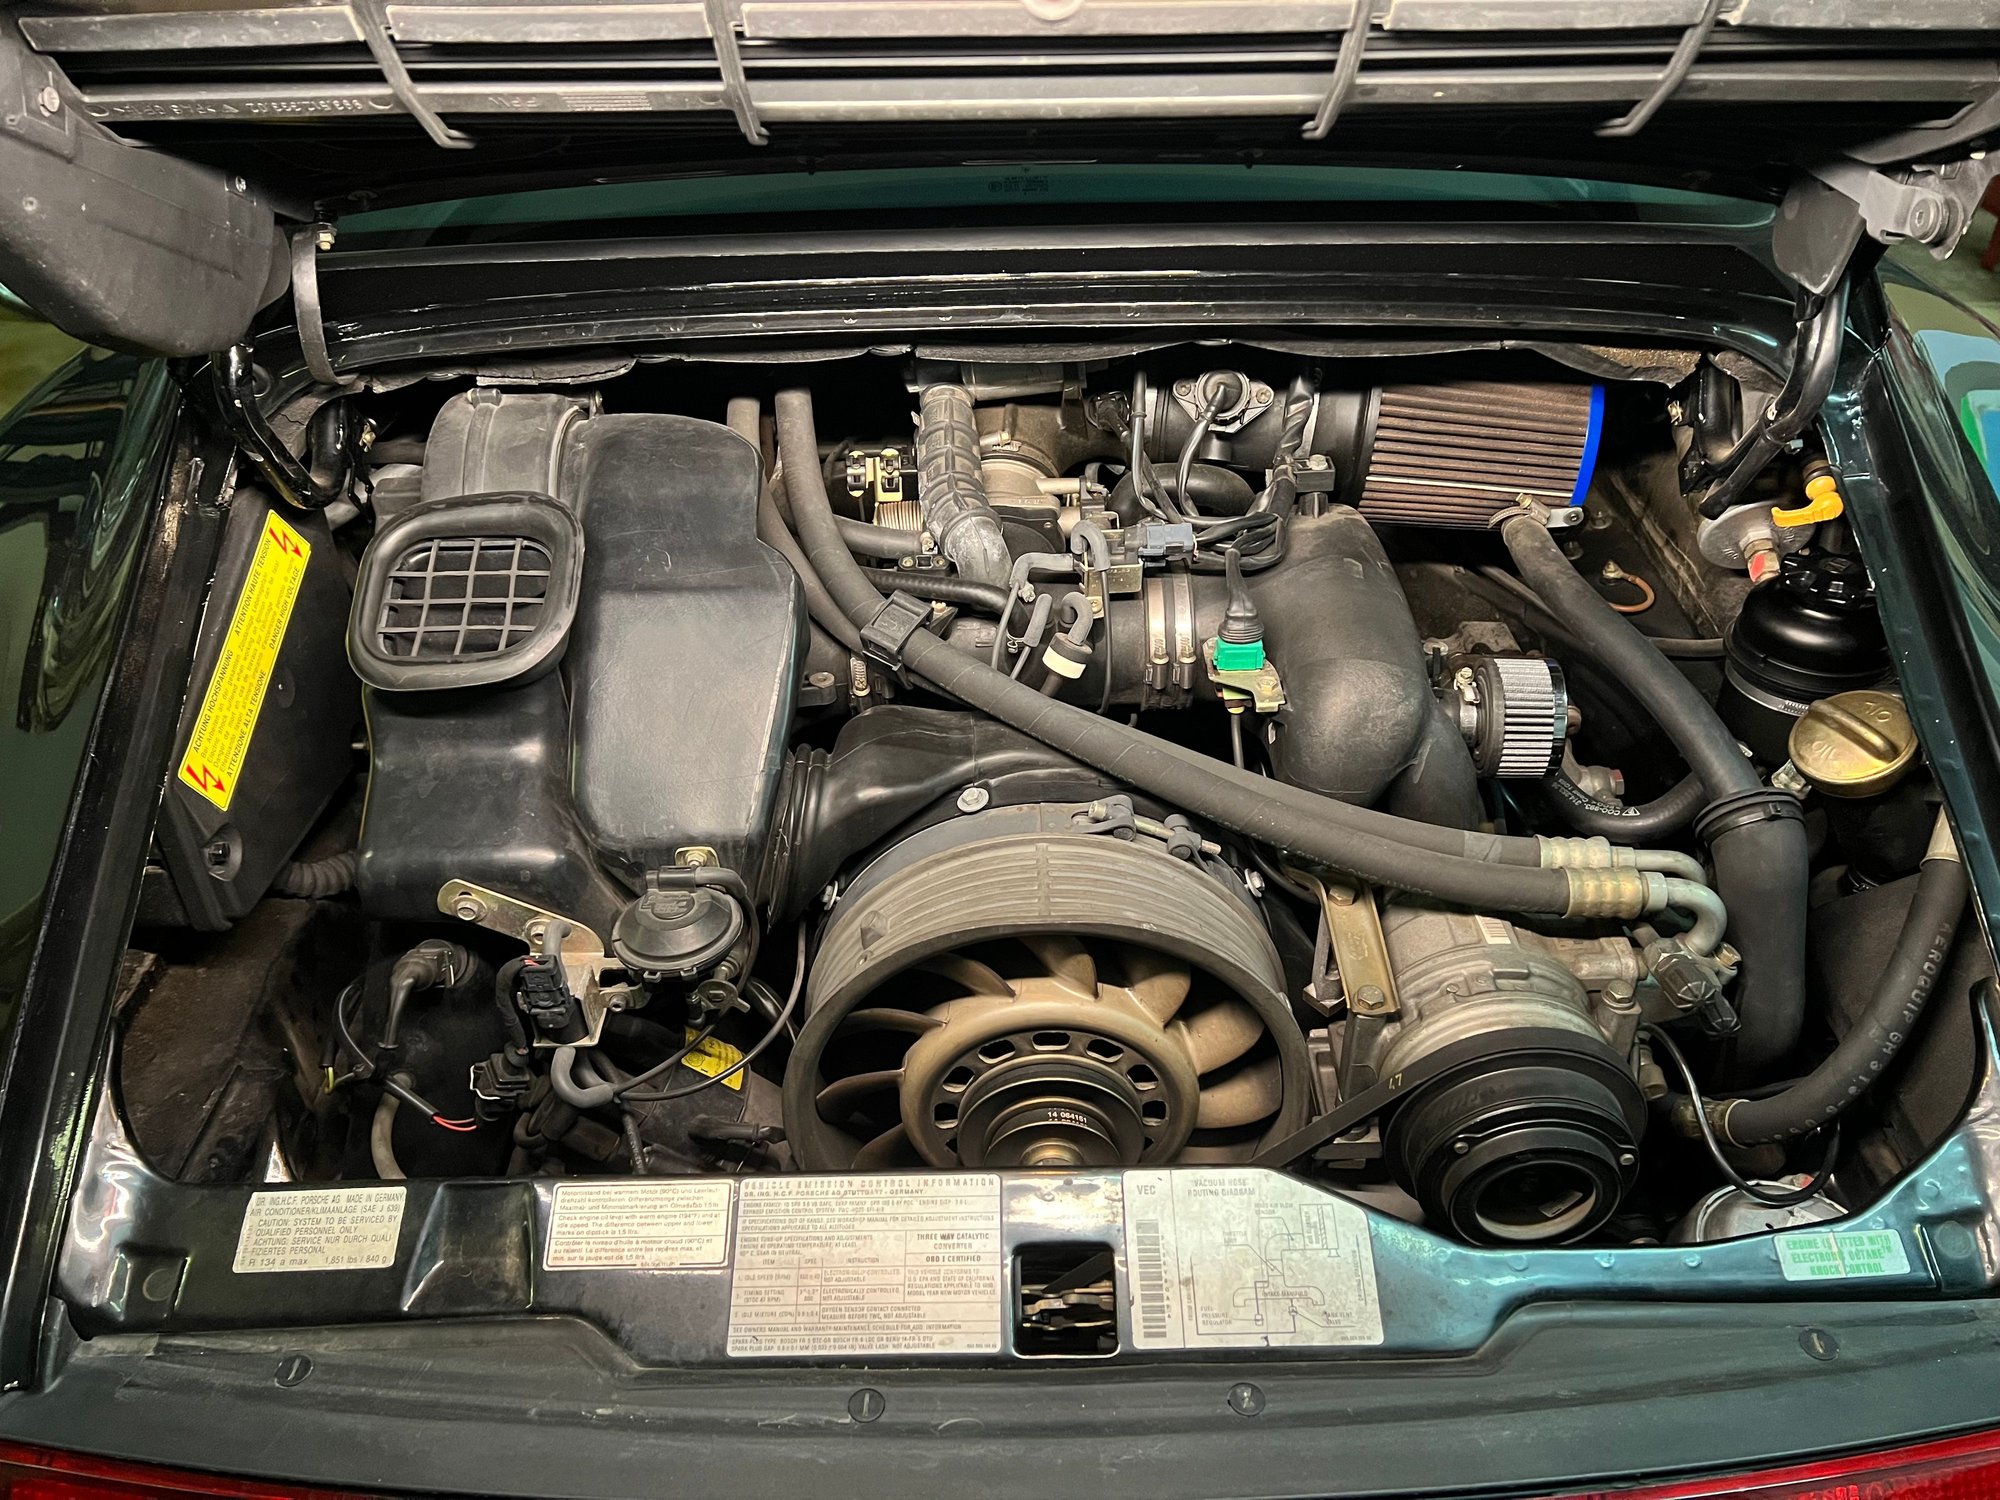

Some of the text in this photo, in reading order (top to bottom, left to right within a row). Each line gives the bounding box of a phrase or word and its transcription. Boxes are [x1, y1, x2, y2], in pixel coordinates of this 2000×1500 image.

[233, 536, 271, 636] ATTENTION HAUTE TENSION
[268, 565, 299, 650] DANGER HIGH VOLTAGE
[192, 647, 233, 754] ACHTUNG HOCHSPANNUNG
[226, 668, 266, 778] ATTENZIONE ALTA TENSIONE
[1902, 922, 1952, 1024] AEROQUIP
[744, 1177, 994, 1189] VEHICLE EMISSION CONTROL INFORMATION
[1136, 1184, 1156, 1195] VEC
[1187, 1188, 1219, 1196] ROUTING
[300, 1192, 403, 1204] PORSCHE AG MADE IN GERMANY
[249, 1203, 400, 1216] AIR CONDITIONER/KLIMAANLAGE (SAE J 639)
[292, 1217, 322, 1226] SYSTEM
[324, 1216, 334, 1225] TO
[337, 1216, 347, 1224] BE
[349, 1214, 385, 1224] SERVICED
[387, 1214, 398, 1223] BY
[254, 1225, 358, 1236] QUALIFIED PERSONNEL ONLY
[252, 1234, 368, 1246] ACHTUNG: SERVICE NUR DURCH
[1786, 1238, 1820, 1250] ENGINE
[1867, 1234, 1891, 1245] WITH
[250, 1245, 326, 1256] FIZIERTES PERSONAL
[259, 1258, 276, 1266] 134
[288, 1257, 308, 1265] max
[346, 1255, 358, 1263] lbs
[364, 1254, 380, 1262] 840
[381, 1254, 387, 1262] g
